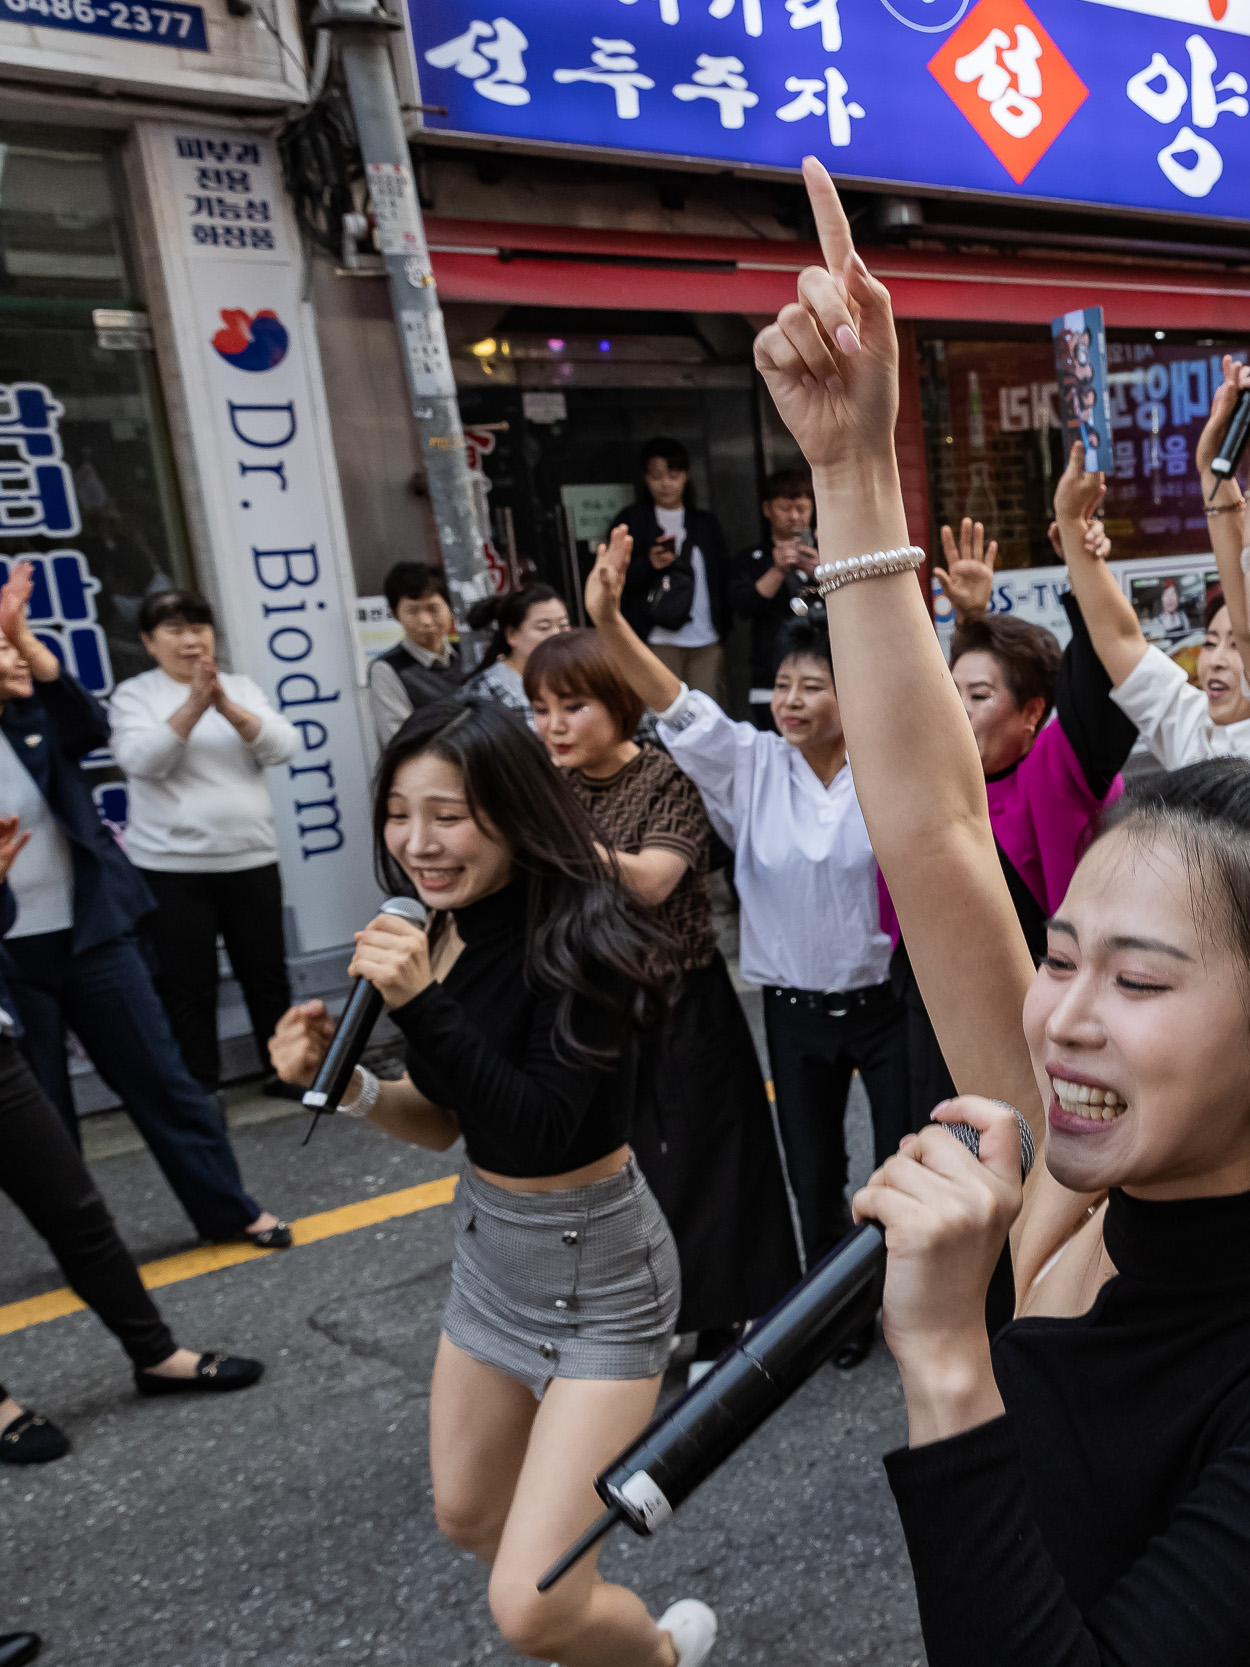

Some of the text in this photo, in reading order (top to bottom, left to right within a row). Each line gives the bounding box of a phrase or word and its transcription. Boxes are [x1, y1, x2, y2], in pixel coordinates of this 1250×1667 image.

[175, 136, 261, 166] 피부과
[185, 194, 271, 223] 기능성
[192, 222, 276, 250] 화장품
[227, 399, 346, 861] Dr. Bioderm
